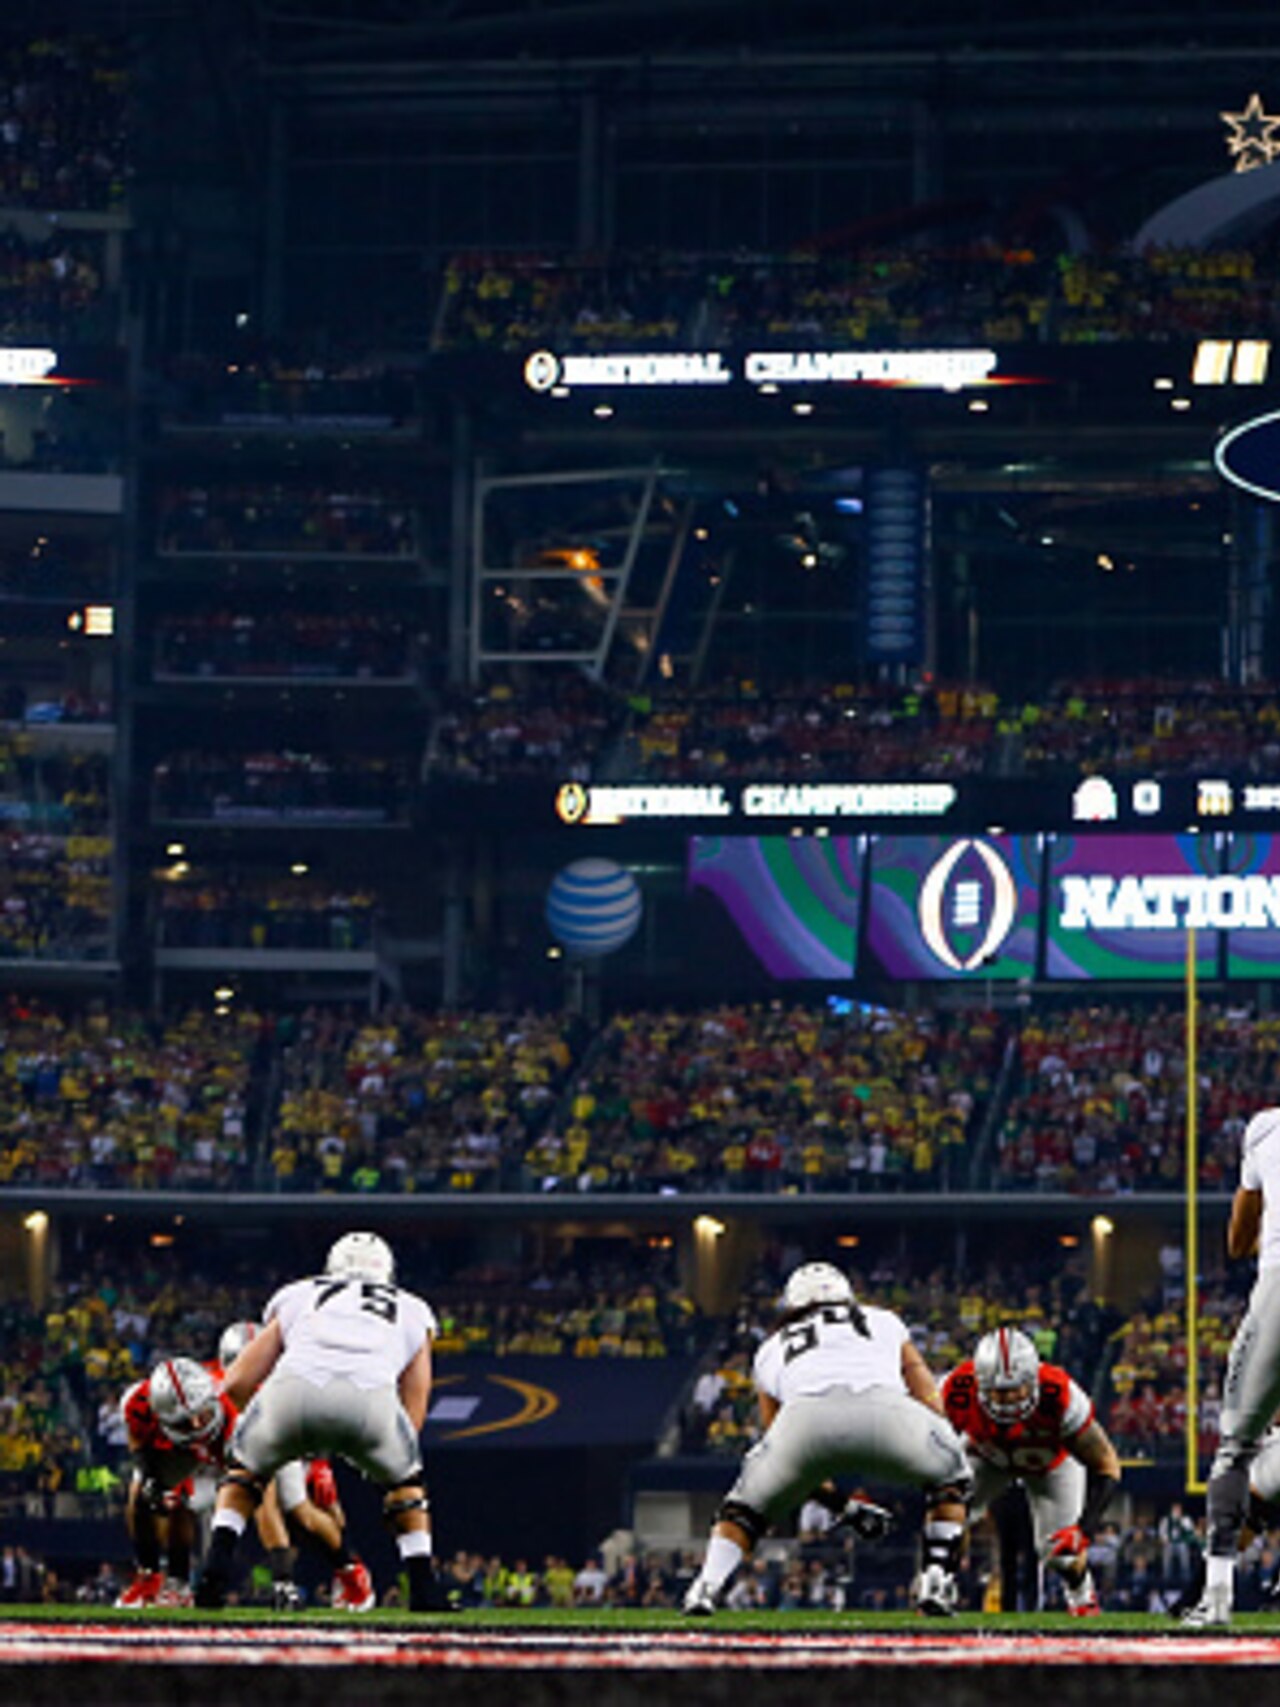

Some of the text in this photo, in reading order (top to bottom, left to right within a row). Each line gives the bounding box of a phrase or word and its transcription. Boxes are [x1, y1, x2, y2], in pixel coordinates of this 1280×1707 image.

[562, 350, 996, 385] NATIONAL CHAMPIONSHIP
[589, 786, 731, 815] NATIONAL
[314, 1279, 397, 1324] 75
